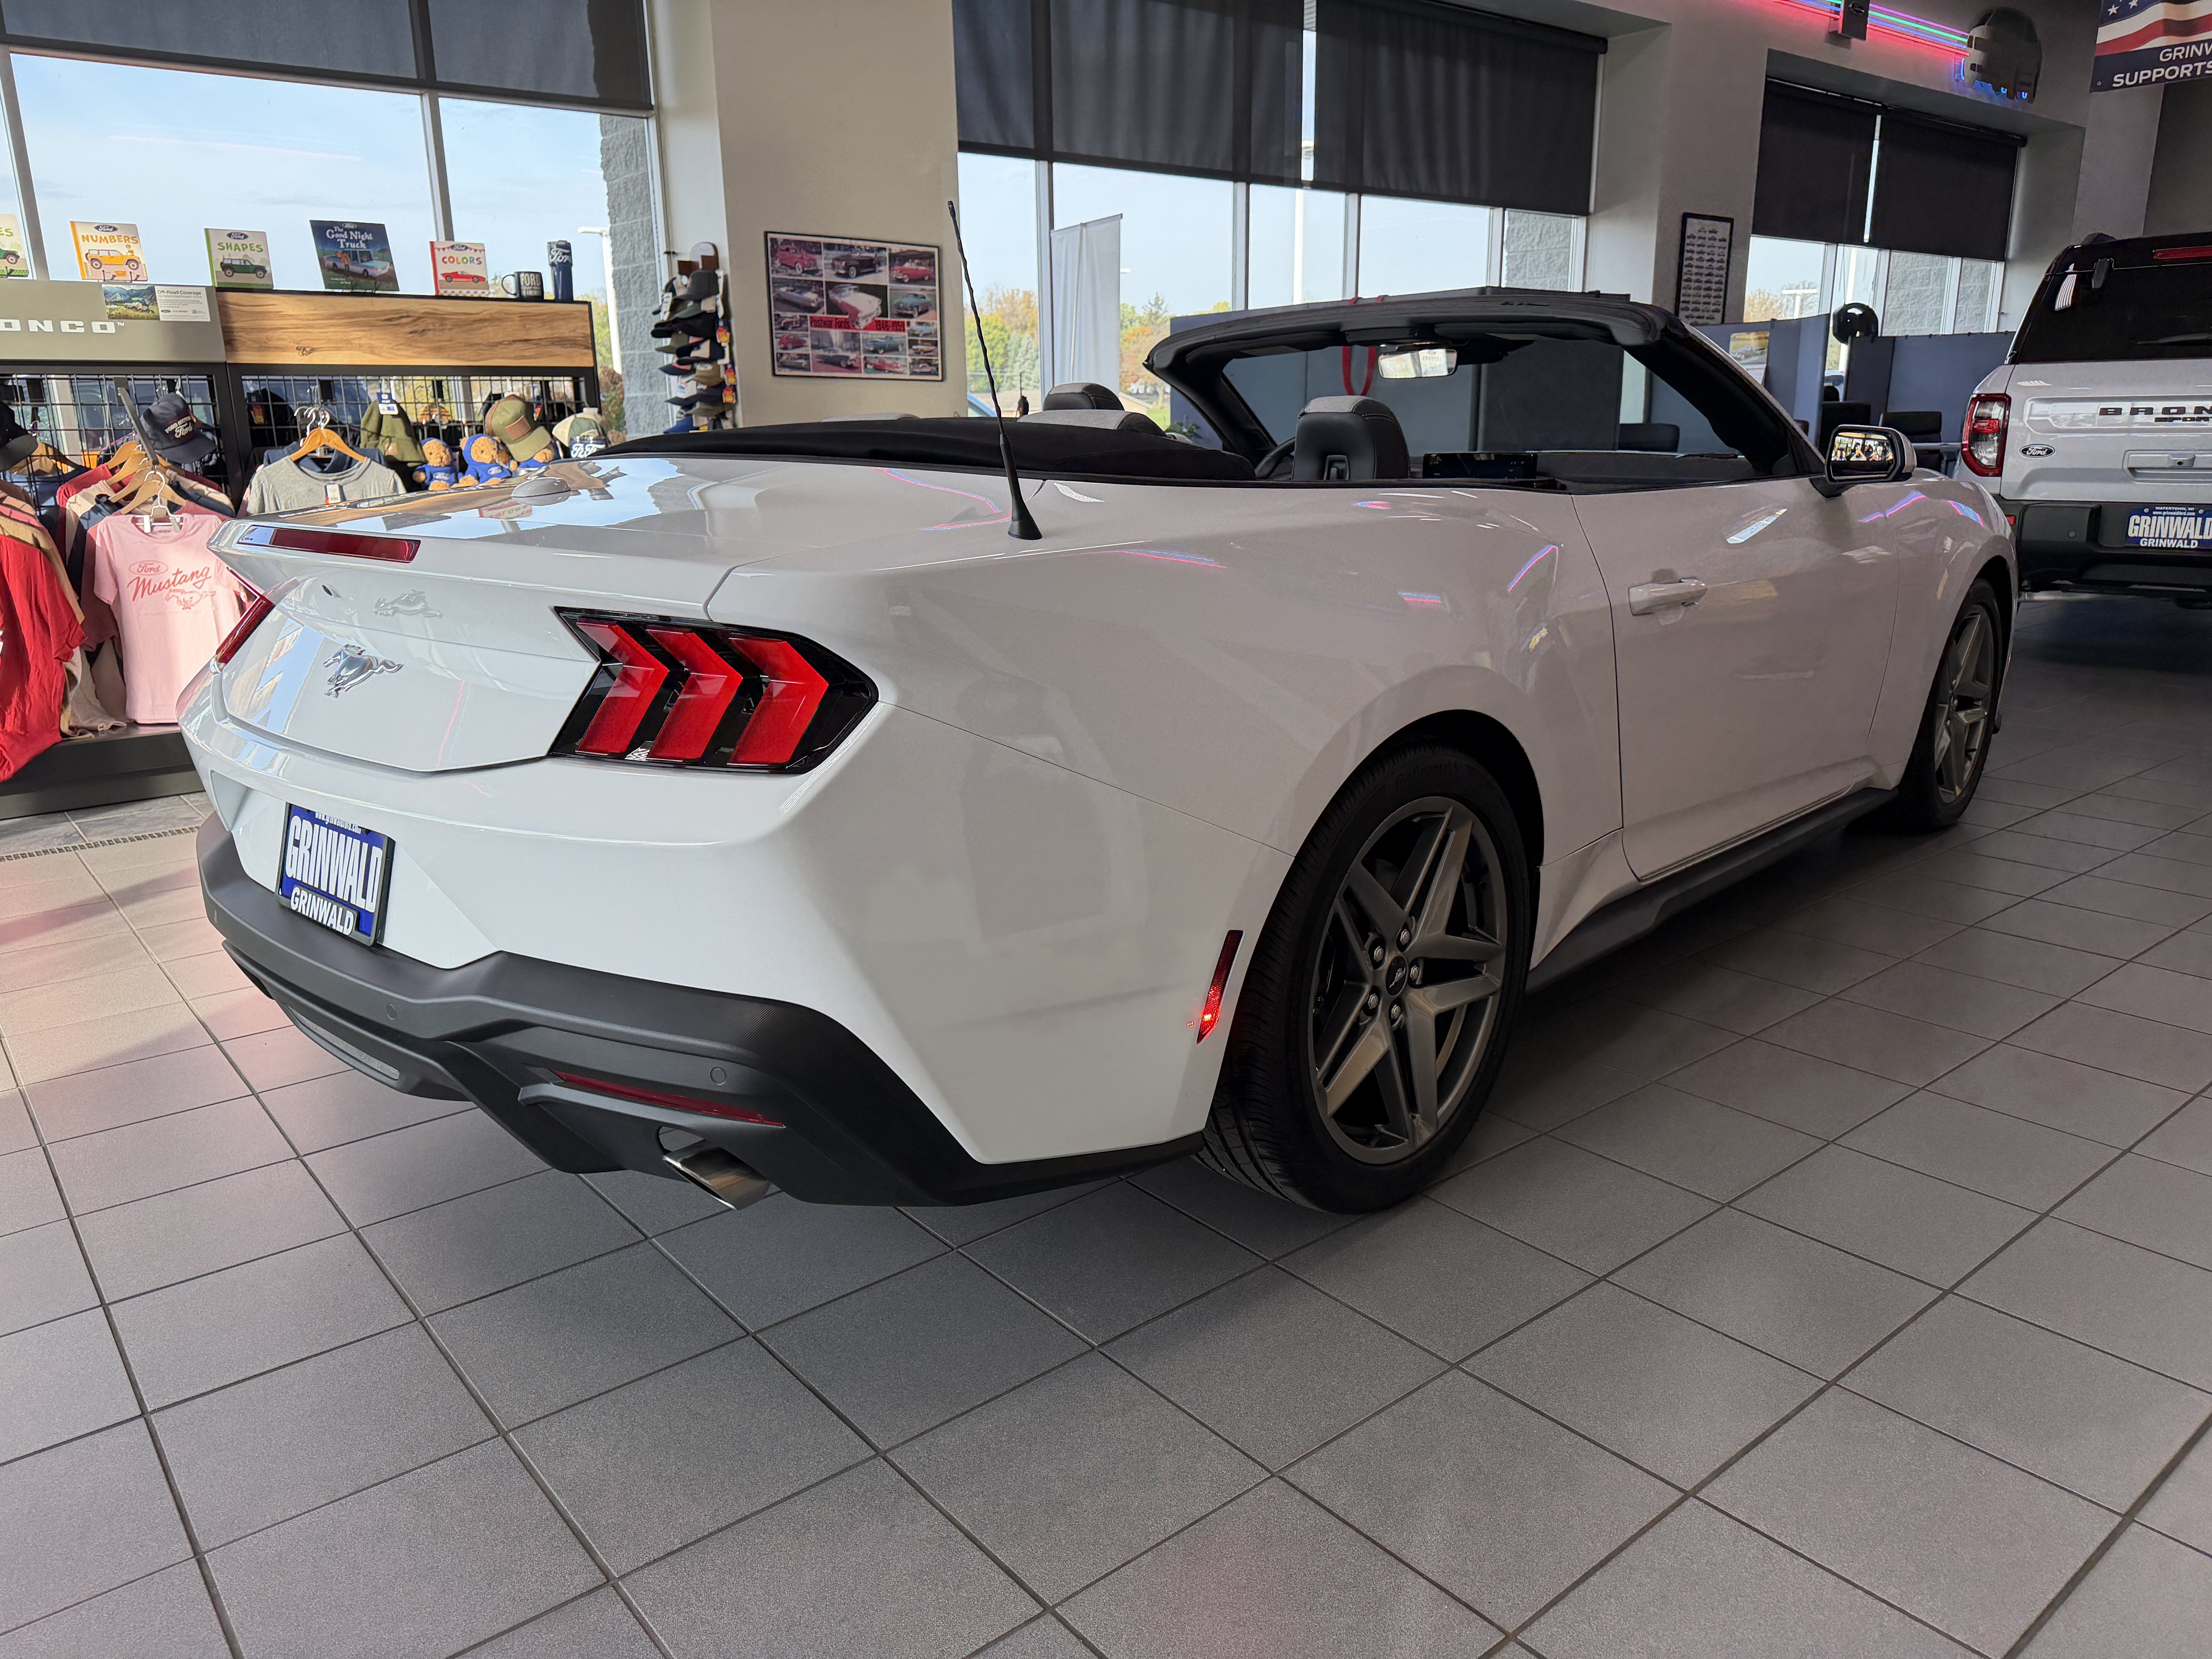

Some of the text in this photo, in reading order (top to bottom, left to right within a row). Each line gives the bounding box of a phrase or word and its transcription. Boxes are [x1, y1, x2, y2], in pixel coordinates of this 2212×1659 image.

[81, 234, 139, 244] NUMBERS
[326, 229, 374, 241] Good Night
[217, 242, 264, 252] SHAPES
[337, 238, 366, 249] Truck
[441, 256, 482, 265] COLORS
[520, 273, 541, 286] FORD
[175, 422, 193, 439] Ford
[2026, 446, 2048, 455] Ford
[2128, 515, 2212, 540] GRINWALD
[2140, 538, 2199, 549] GRINWALD
[137, 563, 161, 574] Ford
[127, 566, 212, 601] Mustang
[285, 815, 383, 913] GRINWALD
[290, 886, 354, 936] GRINWALD
